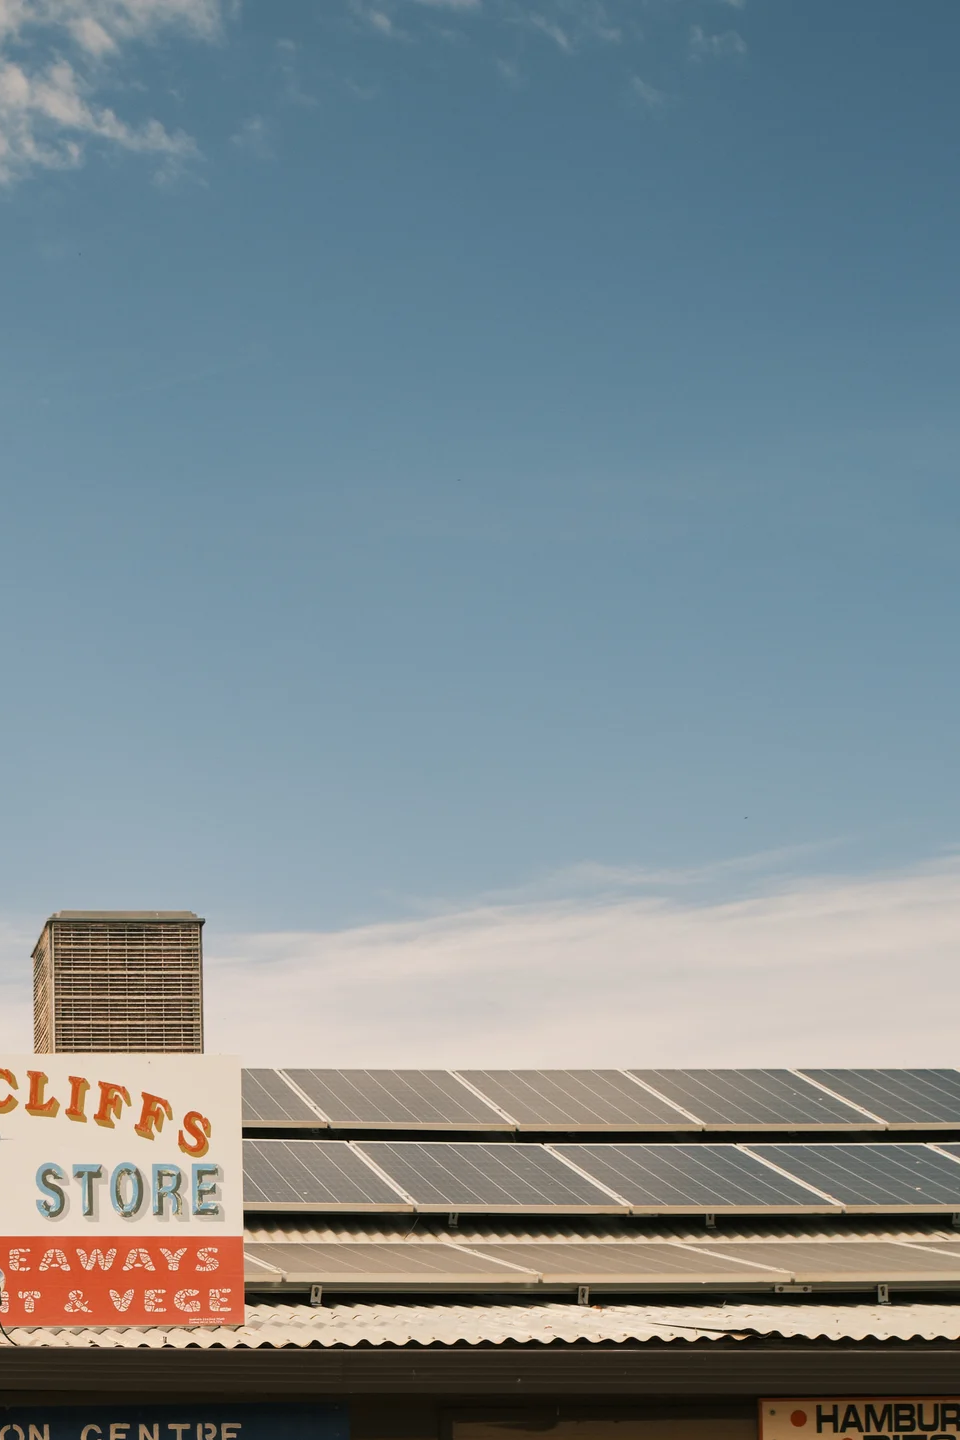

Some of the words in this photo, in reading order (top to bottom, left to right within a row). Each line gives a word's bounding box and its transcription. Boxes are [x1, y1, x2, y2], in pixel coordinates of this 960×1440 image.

[34, 1162, 224, 1221] STORE
[63, 1290, 92, 1313] &
[108, 1288, 232, 1313] VEGE
